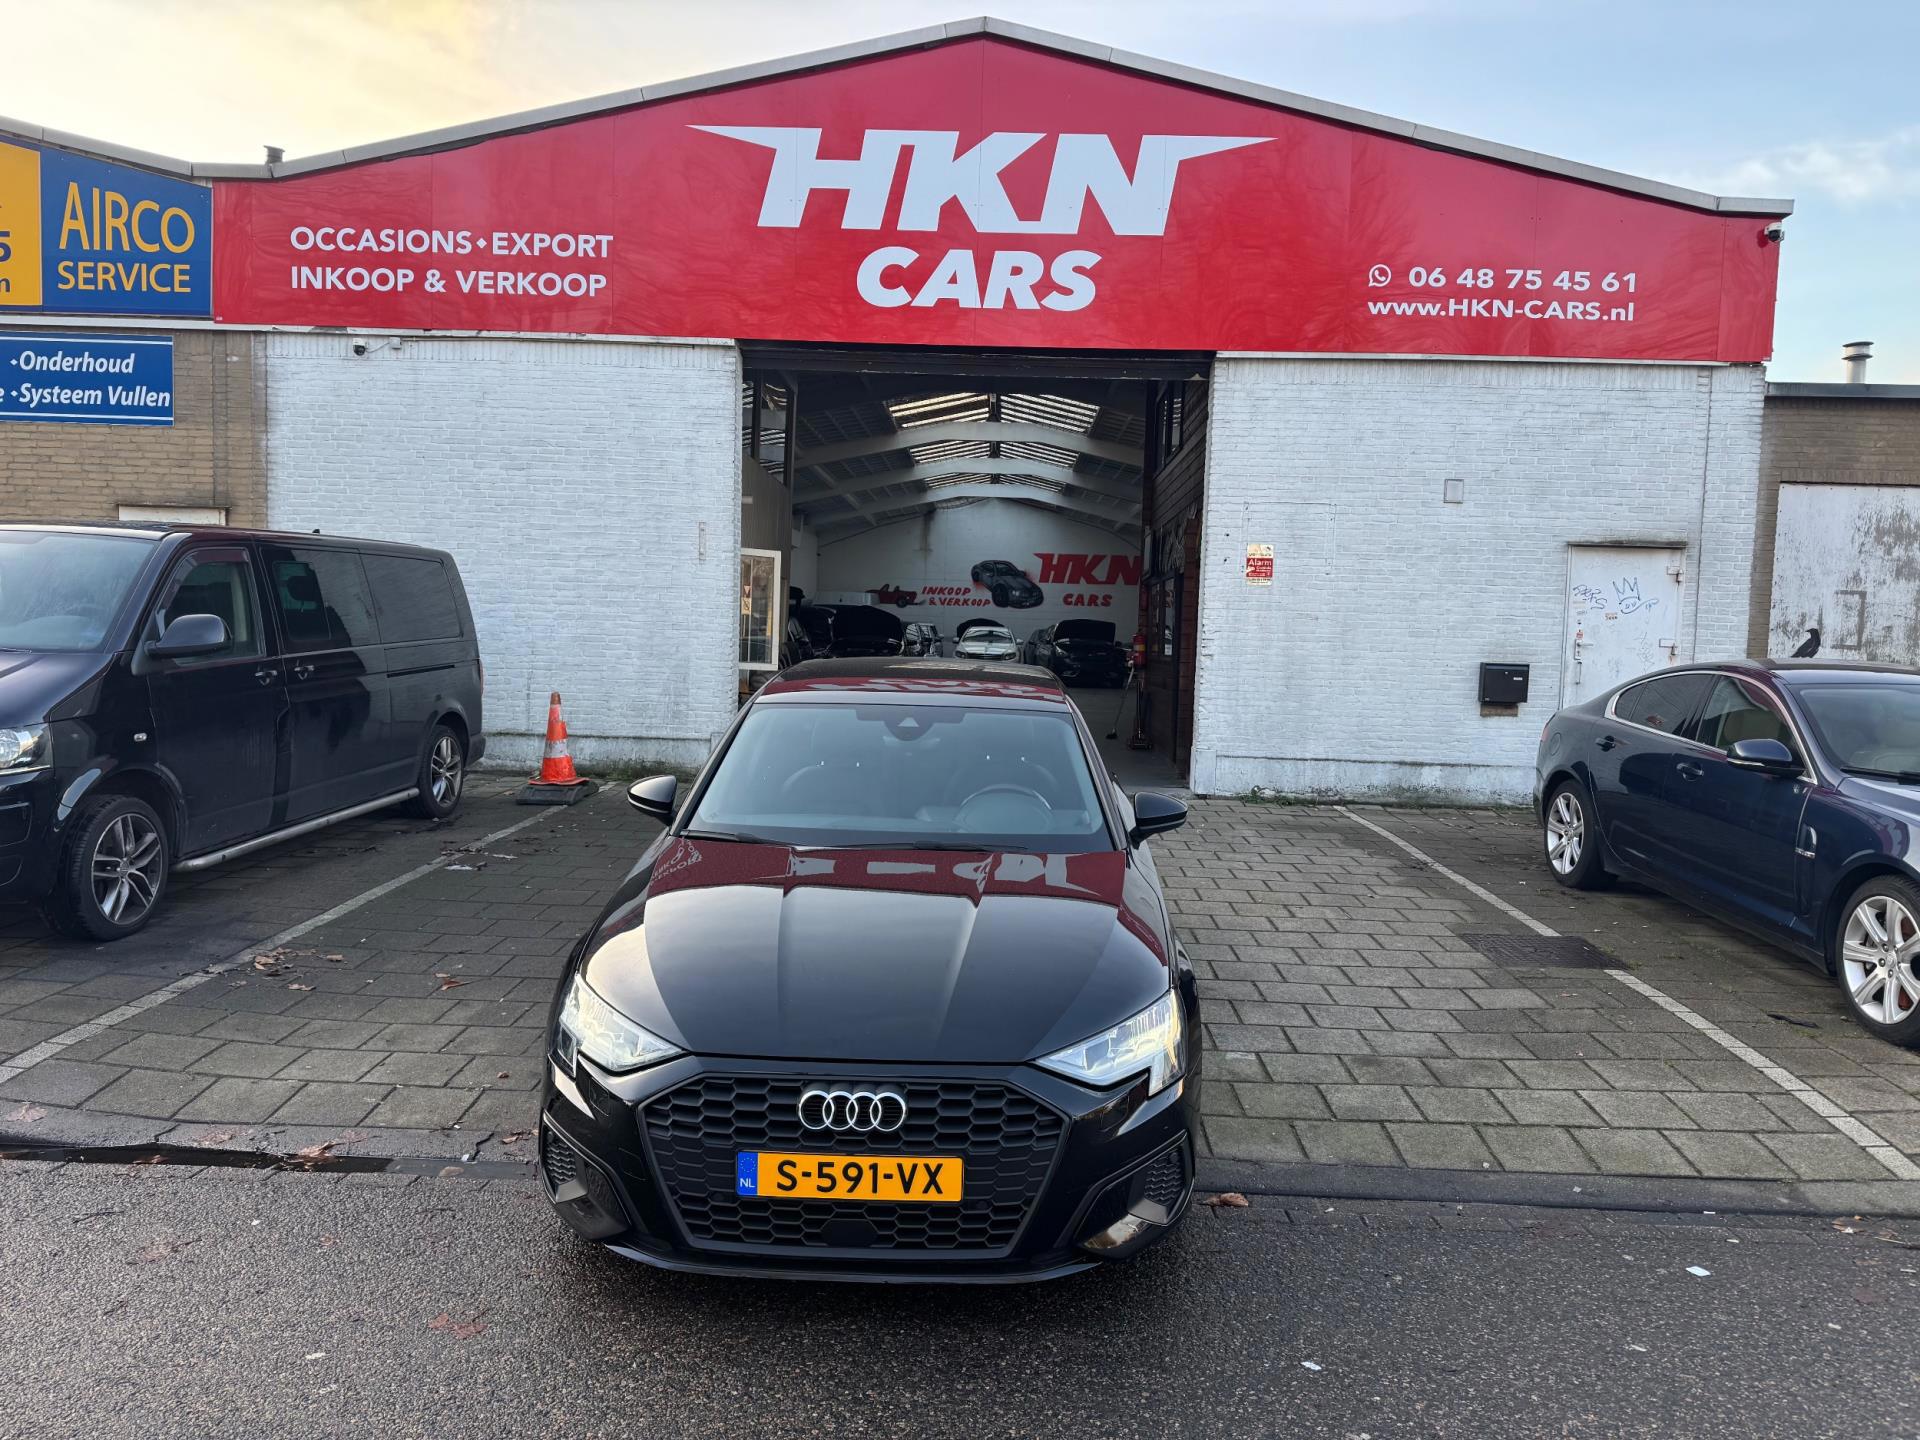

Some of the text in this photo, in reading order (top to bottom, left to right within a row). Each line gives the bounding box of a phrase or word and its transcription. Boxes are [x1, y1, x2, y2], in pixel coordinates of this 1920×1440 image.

[685, 124, 1278, 237] HKN
[59, 181, 196, 254] AIRCO
[290, 226, 614, 258] OCCASIONS EXPORT
[57, 260, 192, 293] SERVICE
[291, 266, 607, 297] INKOOP & VERKOOP
[856, 246, 1103, 312] CARS
[1408, 266, 1637, 293] 06 48 75 45 61
[1367, 298, 1635, 322] www.HKN-CARS.nl
[19, 350, 135, 374] Onderhoud
[19, 382, 103, 409] Systeem
[107, 385, 171, 407] Vullen
[1033, 553, 1143, 585] HKN
[1248, 558, 1272, 566] Alarm
[921, 586, 971, 596] INKOOP
[1062, 593, 1113, 607] CARS
[739, 1177, 756, 1189] NL
[776, 1159, 944, 1195] S-591-VX
